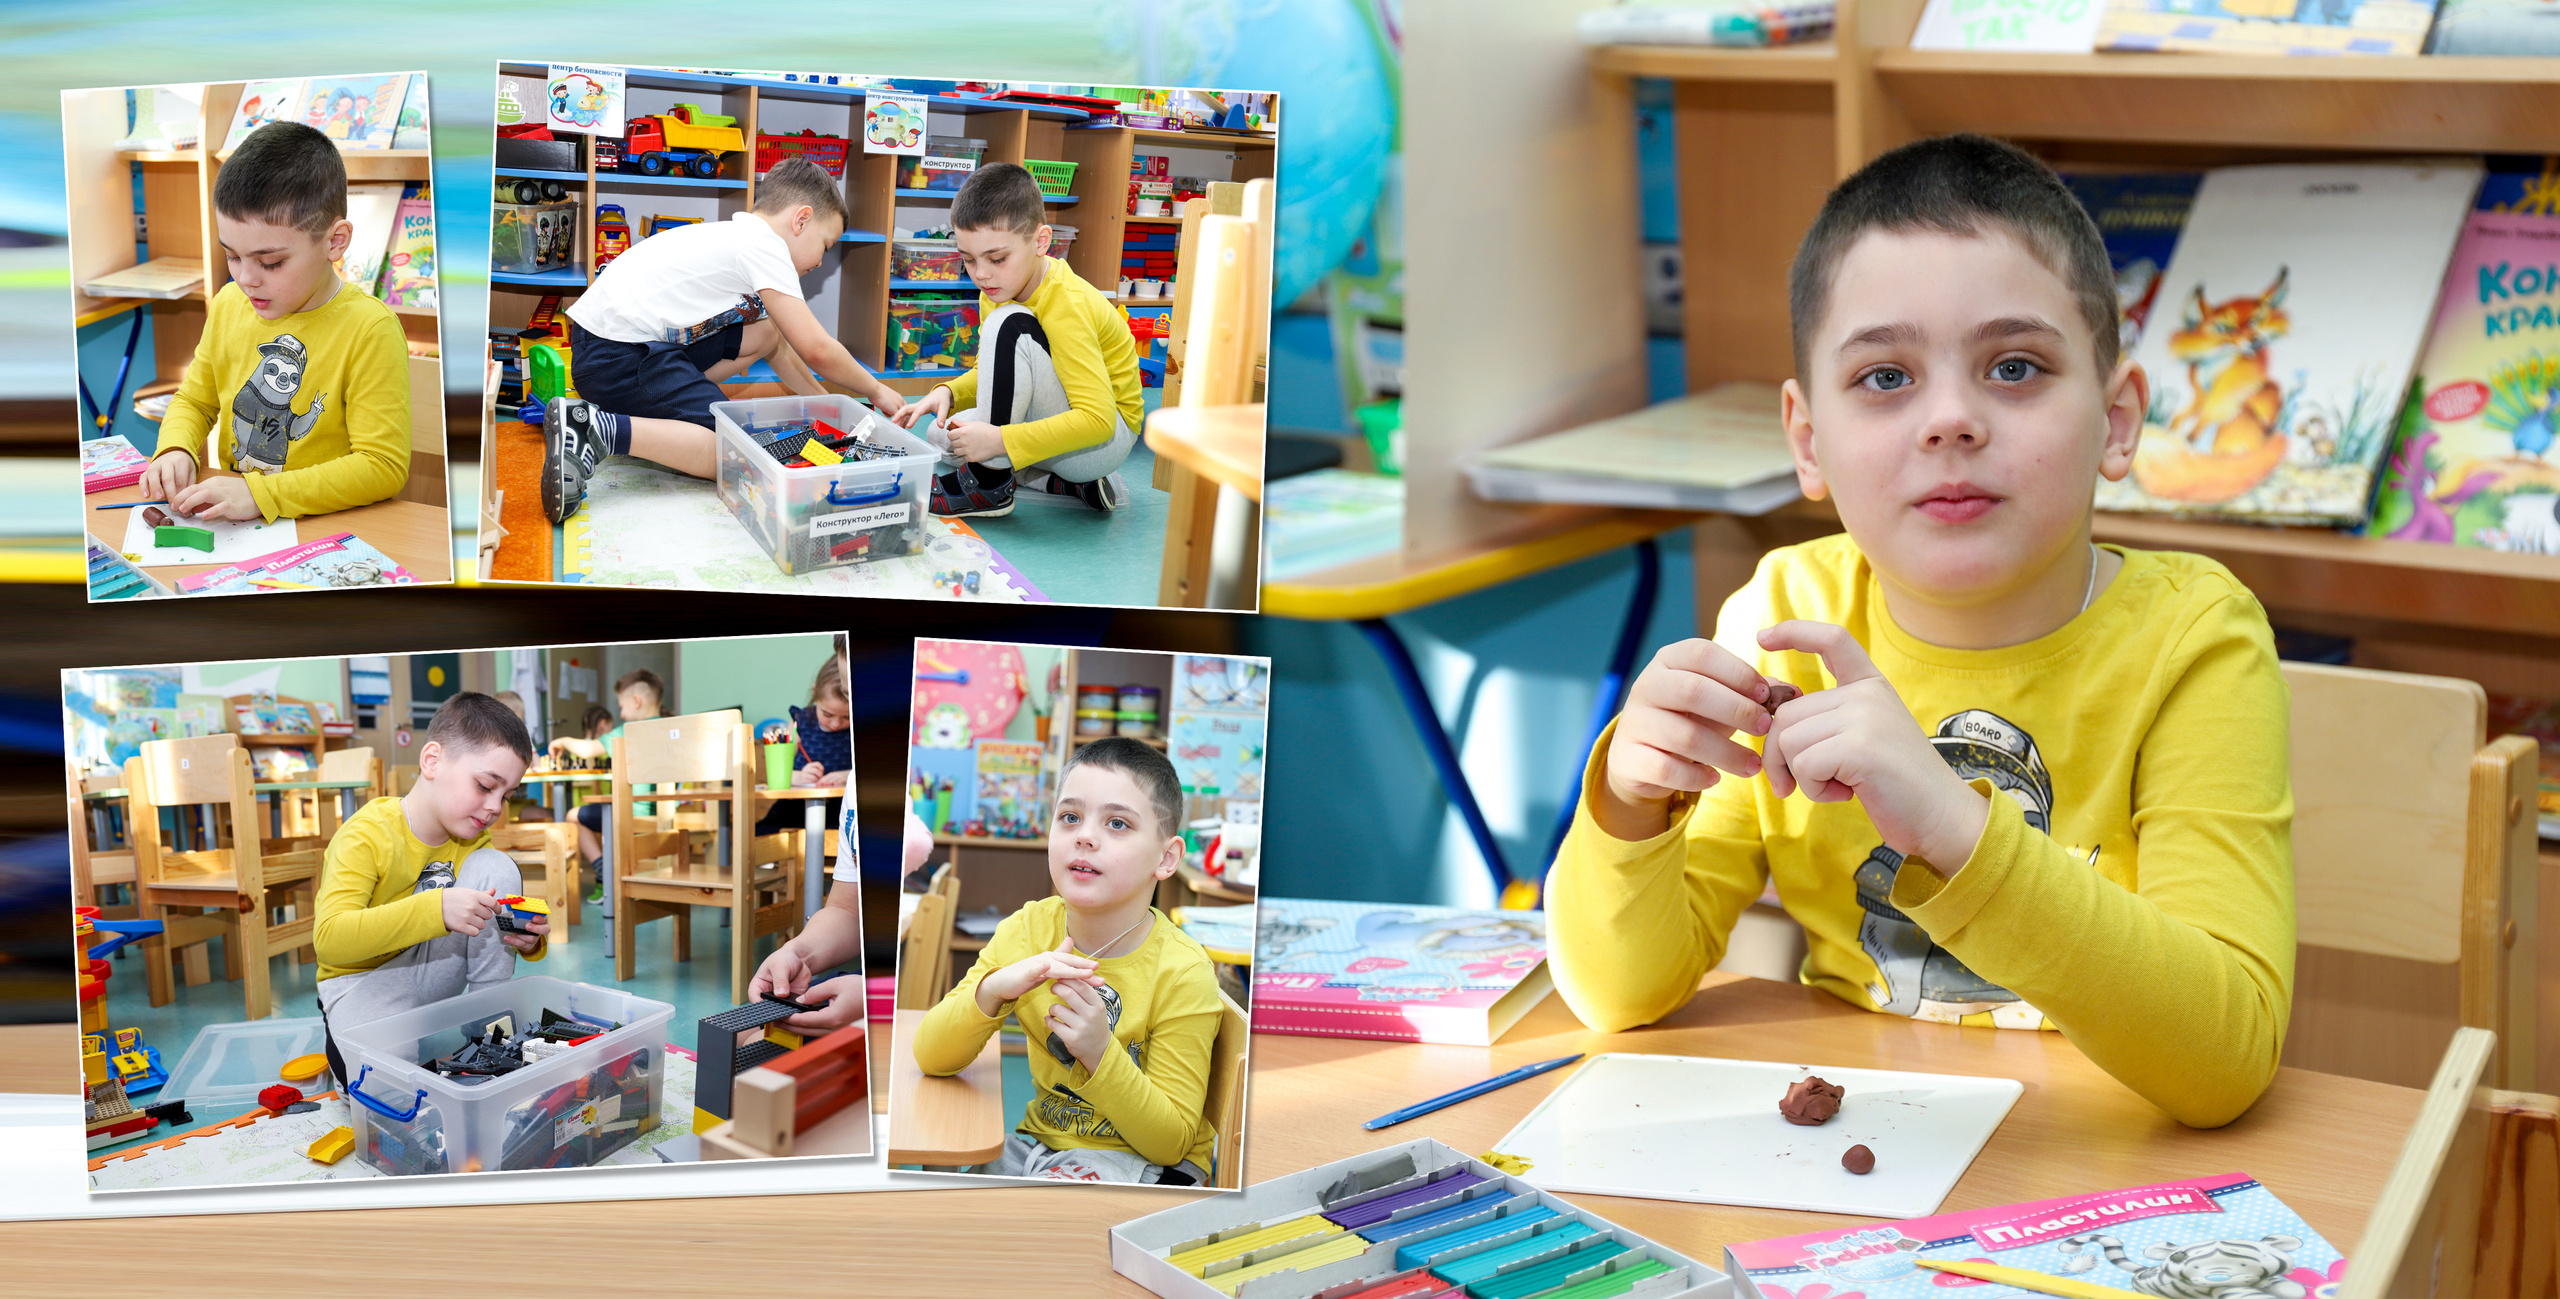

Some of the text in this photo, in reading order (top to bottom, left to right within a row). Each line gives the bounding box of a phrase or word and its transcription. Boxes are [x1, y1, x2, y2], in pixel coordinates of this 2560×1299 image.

[574, 66, 623, 77] безопасности
[924, 159, 972, 170] конструктор
[816, 511, 905, 529] Конструктор «Лего»
[266, 540, 336, 571] Пластилин
[1965, 722, 2001, 742] BOARD
[1040, 1093, 1095, 1137] SKATE
[1983, 1193, 2193, 1243] Пластилин
[1798, 1241, 1899, 1271] Teddy
[1804, 1228, 1901, 1256] Tatty
